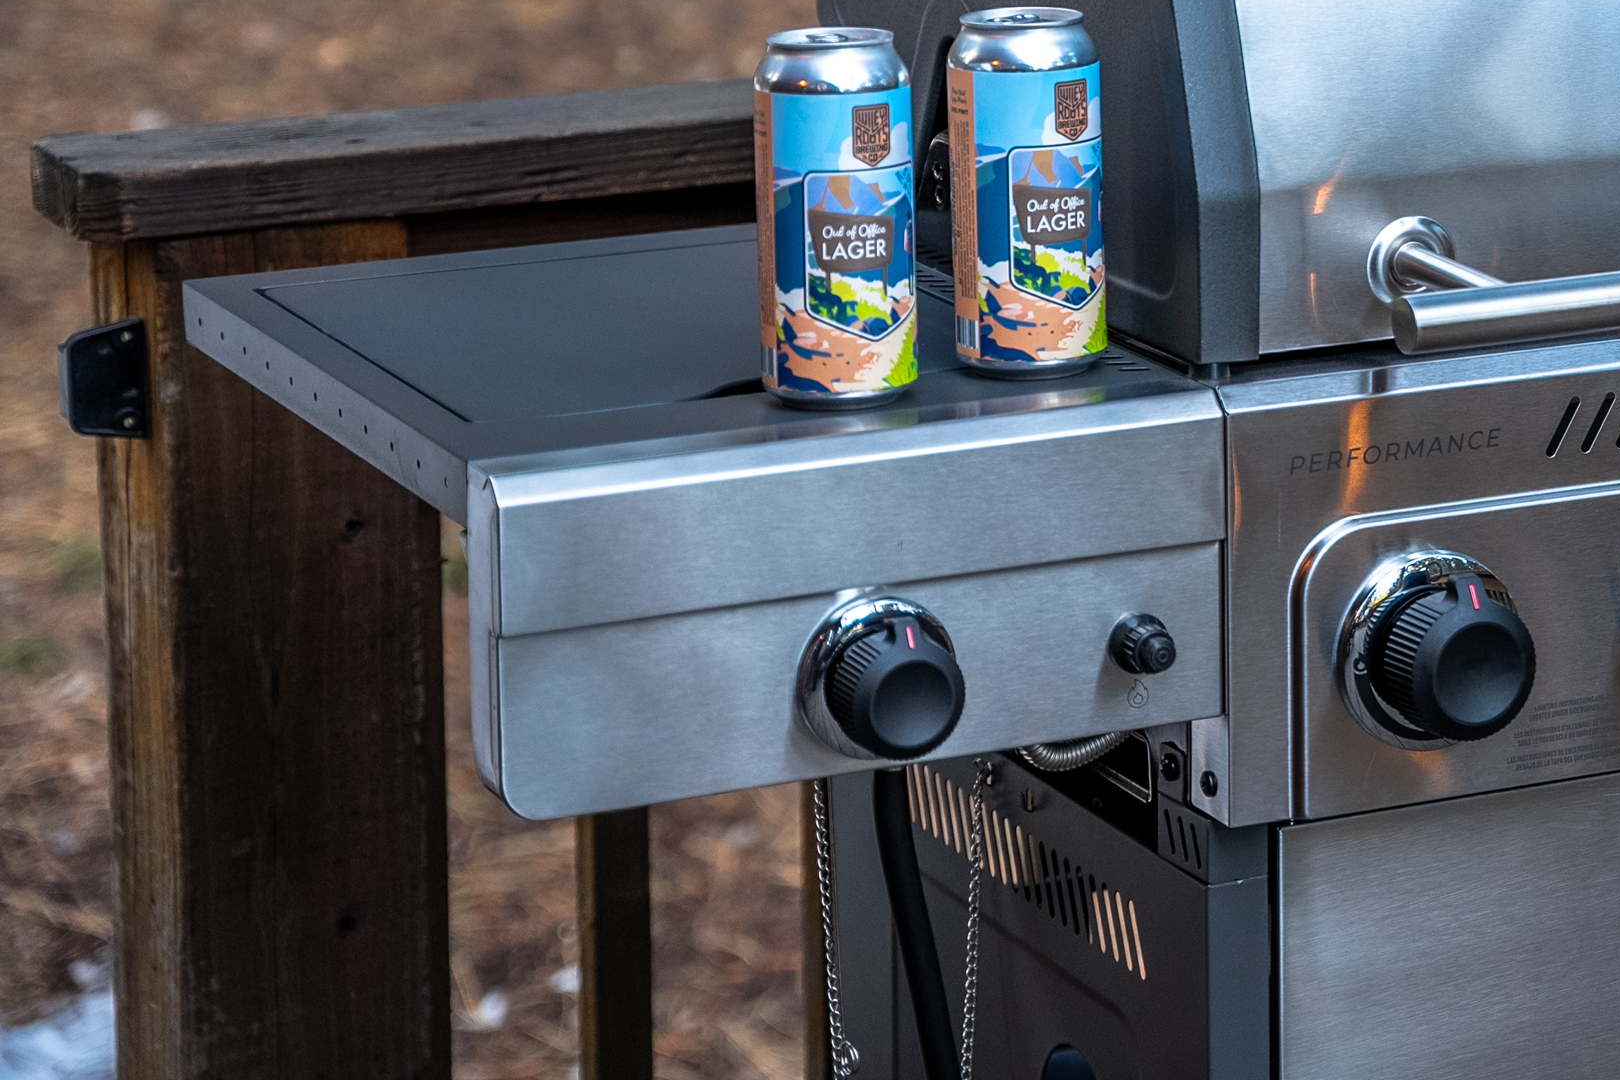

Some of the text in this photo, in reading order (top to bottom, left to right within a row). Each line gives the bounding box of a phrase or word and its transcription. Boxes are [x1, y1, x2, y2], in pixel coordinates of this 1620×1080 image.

[1058, 97, 1086, 120] ROOTS
[856, 122, 888, 145] ROOTS
[856, 143, 888, 154] BREWING
[1027, 195, 1085, 213] Out of Office
[822, 222, 886, 240] Out of Office
[1027, 211, 1085, 233] LAGER
[822, 239, 886, 260] LAGER
[1290, 428, 1501, 475] PERFORMANCE
[1506, 756, 1517, 765] LAS
